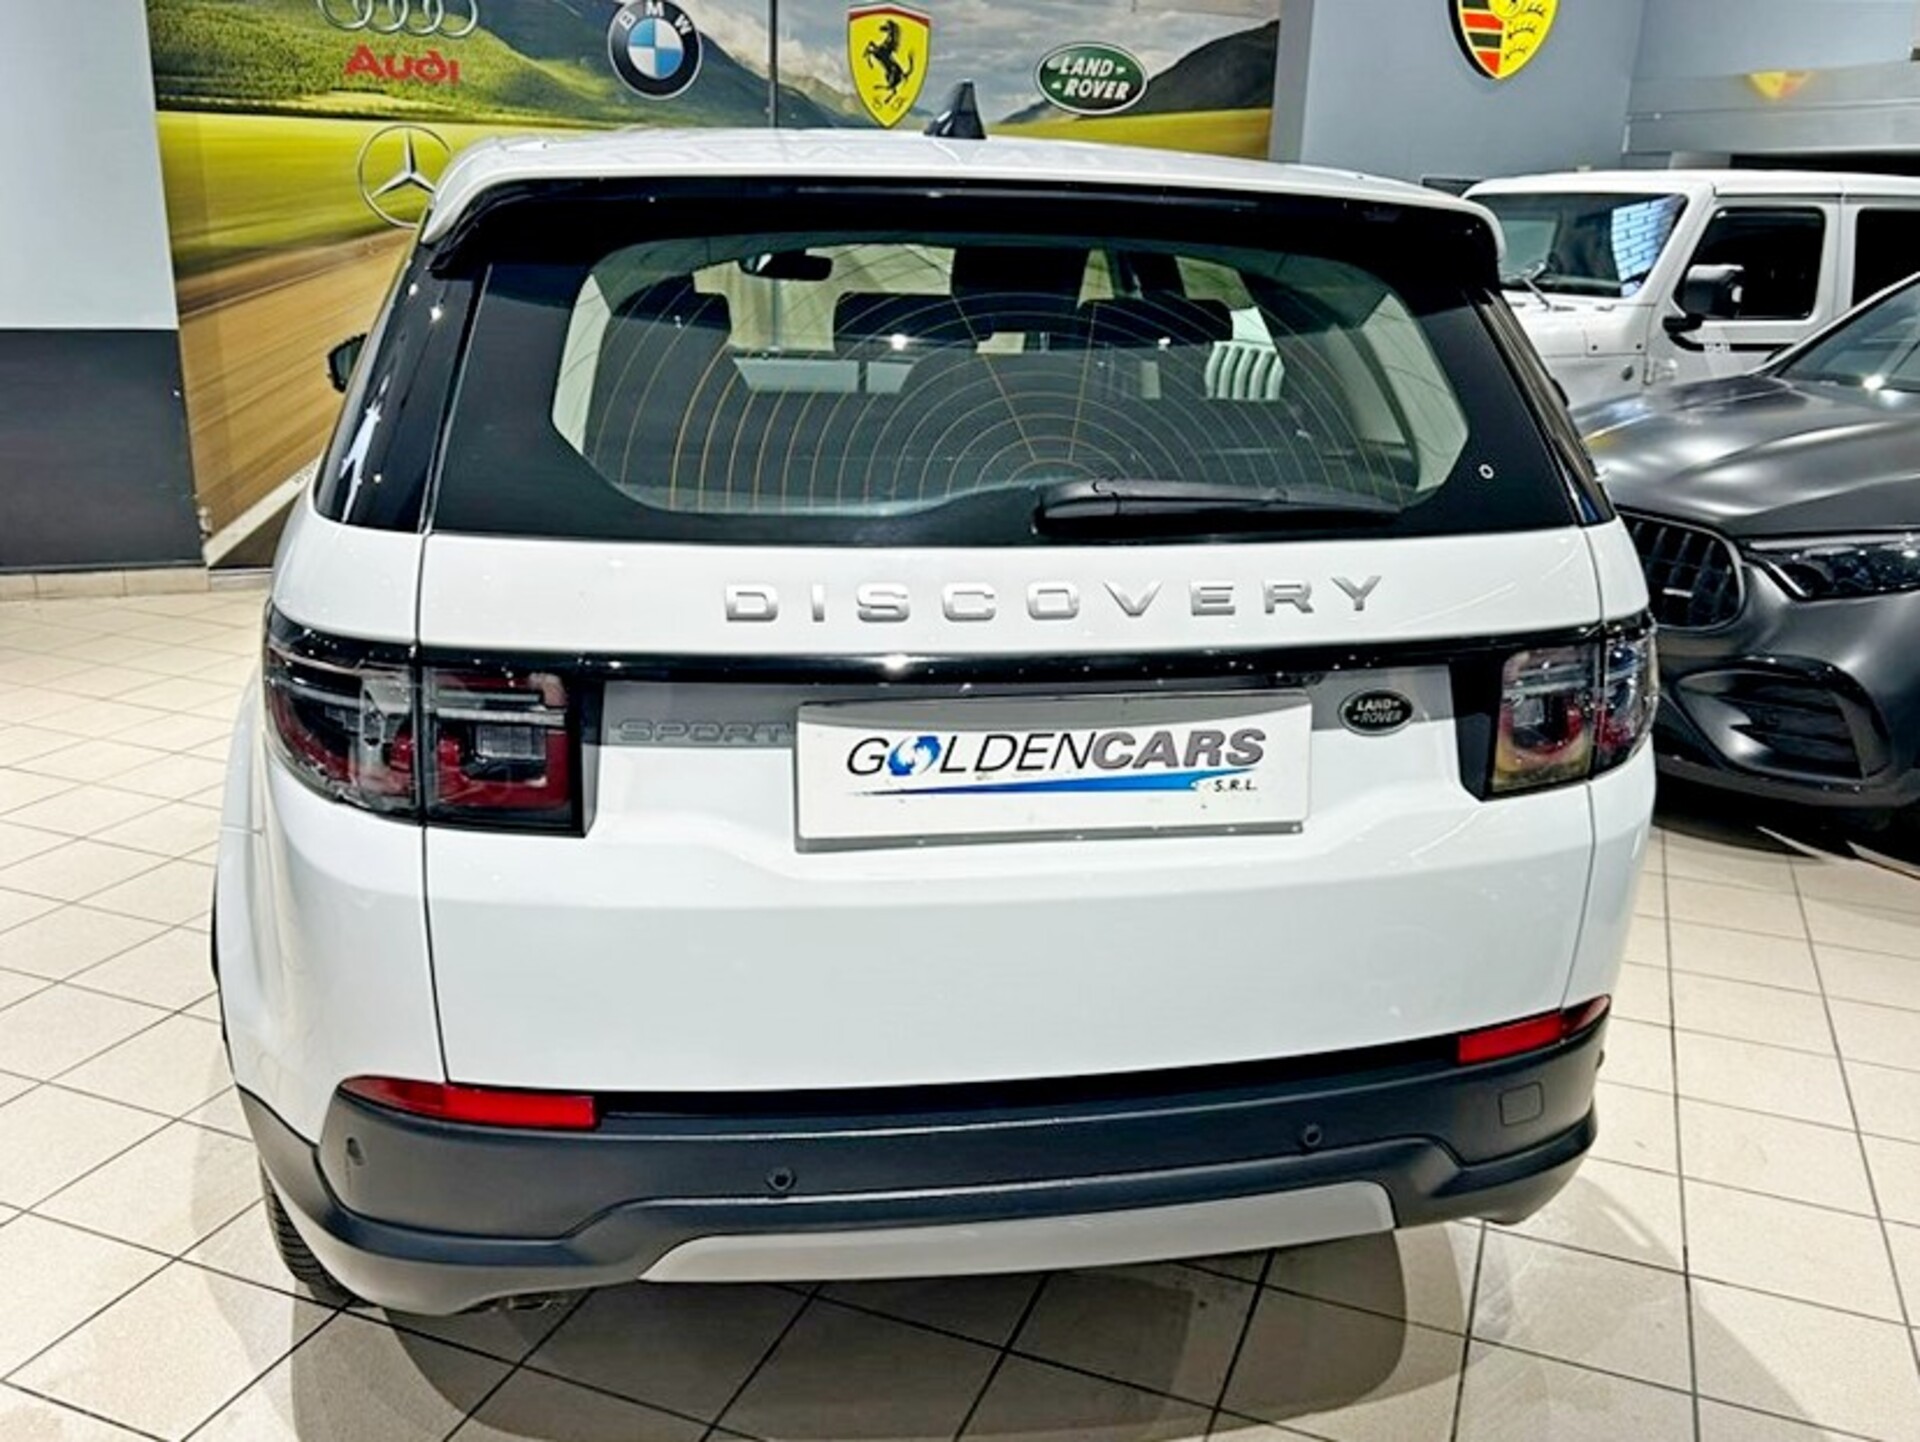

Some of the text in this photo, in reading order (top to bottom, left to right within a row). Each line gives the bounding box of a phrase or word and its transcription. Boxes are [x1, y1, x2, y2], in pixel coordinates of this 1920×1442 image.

[619, 1, 693, 35] BMW
[344, 43, 460, 86] Audi
[1060, 56, 1114, 77] LAND
[1063, 78, 1130, 100] ROVER
[725, 575, 1382, 622] DISCOVERY
[1357, 699, 1392, 711] LAND
[619, 719, 790, 742] SPORT
